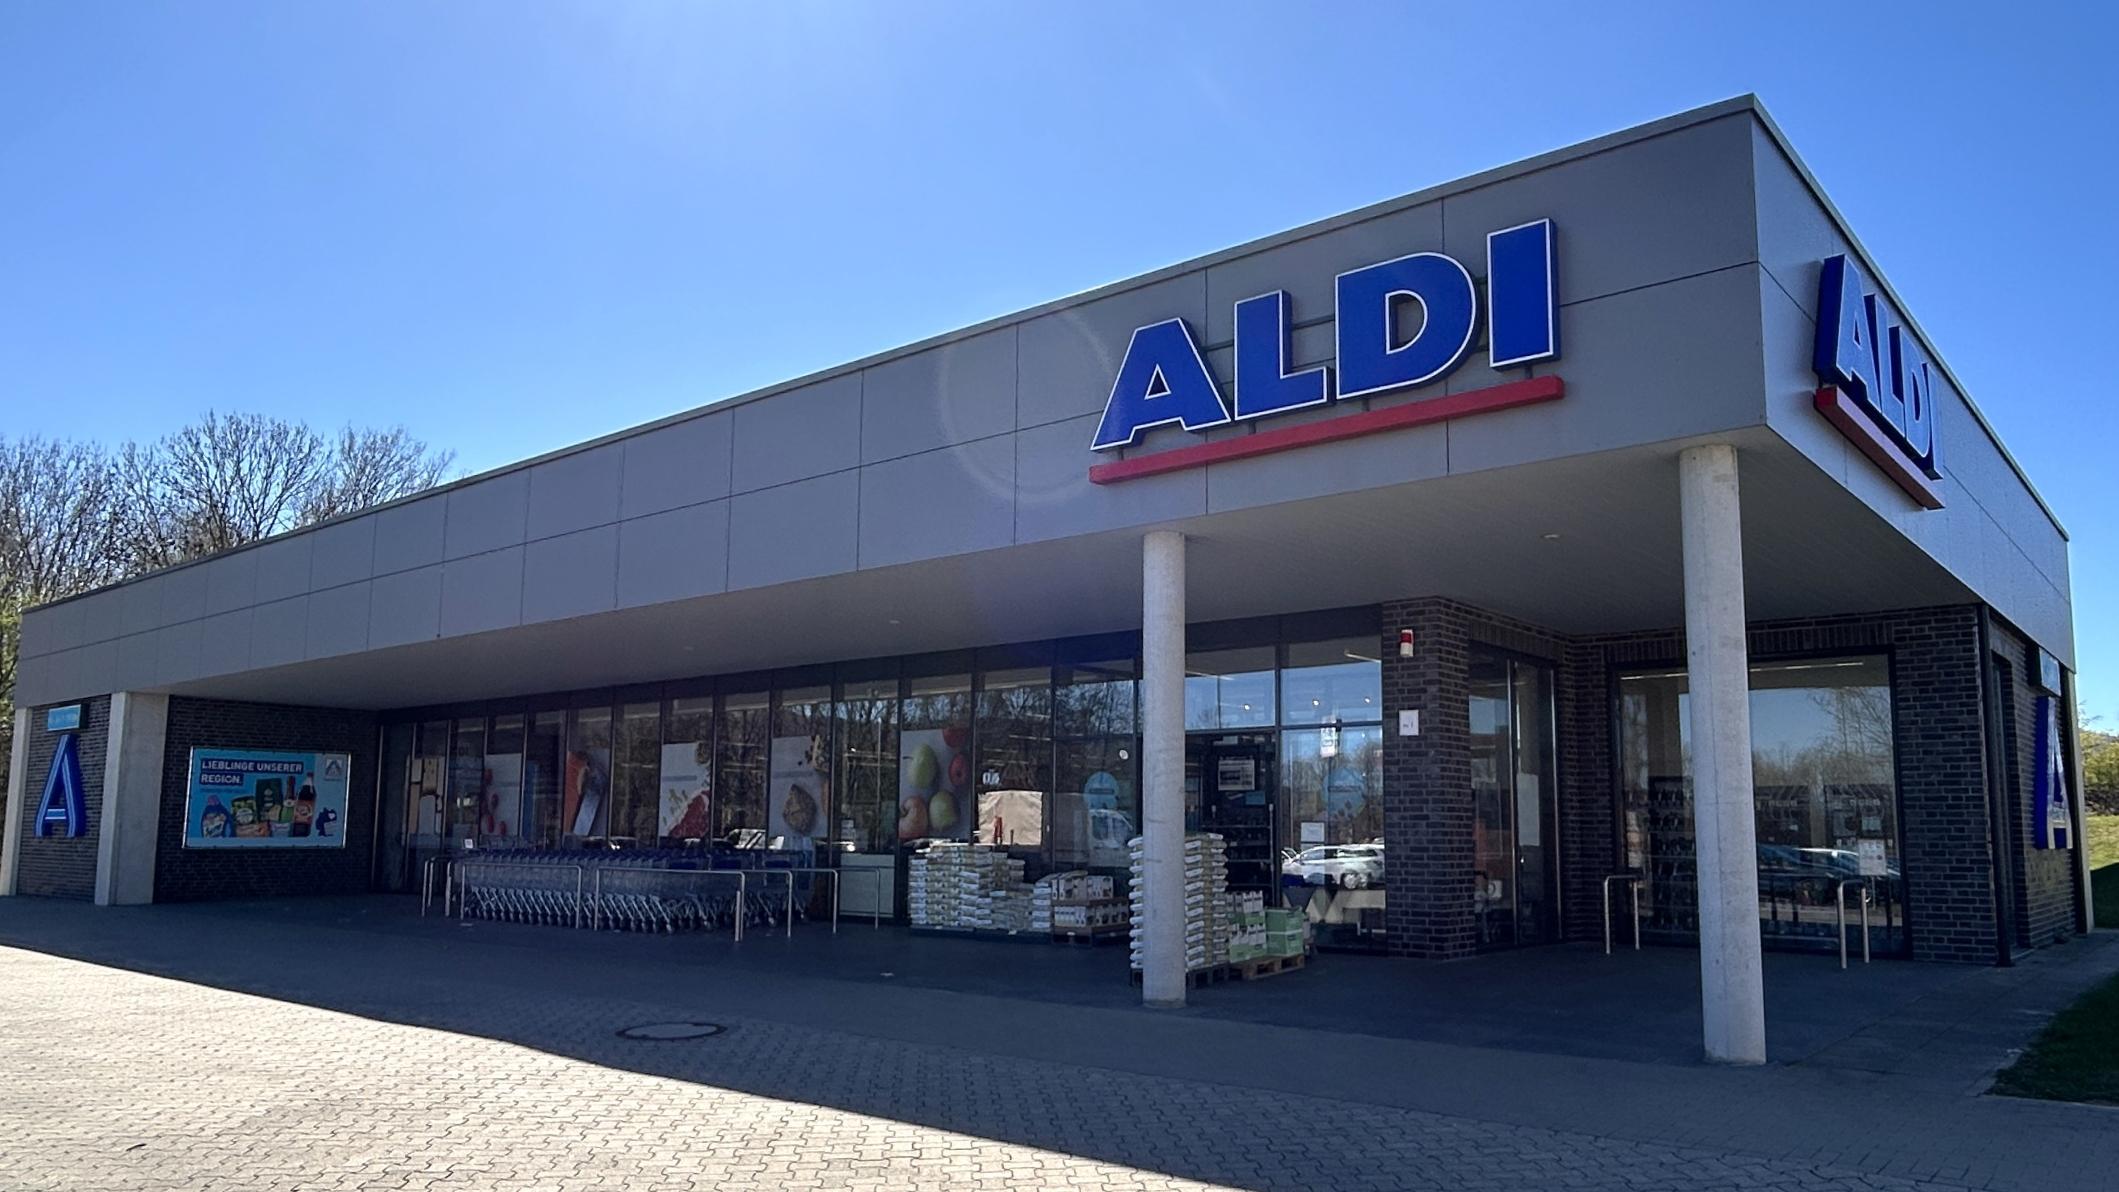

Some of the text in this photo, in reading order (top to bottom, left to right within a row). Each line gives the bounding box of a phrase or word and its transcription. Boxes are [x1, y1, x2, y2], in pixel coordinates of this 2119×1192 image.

[1090, 217, 1560, 453] ALDI
[1816, 254, 1944, 480] ALDI
[201, 760, 303, 773] LIEBLINGE UNSERER
